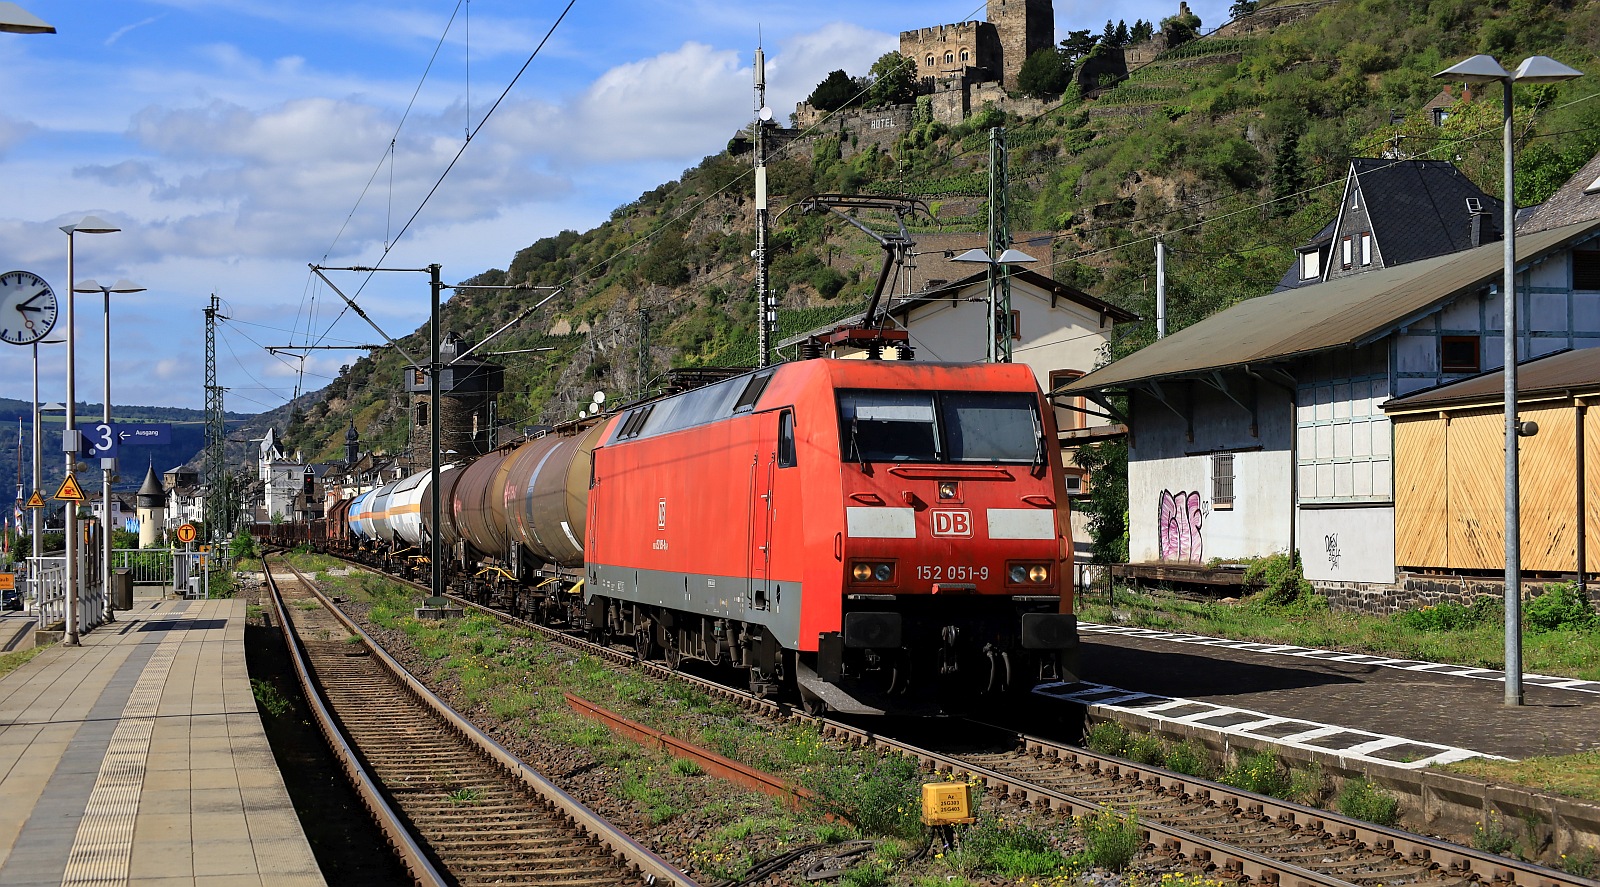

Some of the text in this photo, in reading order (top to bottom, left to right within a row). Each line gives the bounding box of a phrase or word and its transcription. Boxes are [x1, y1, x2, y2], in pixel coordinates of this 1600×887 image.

[871, 118, 895, 129] HOTEL
[95, 424, 113, 451] 3
[935, 512, 969, 533] DB
[916, 565, 989, 580] 152 051-9
